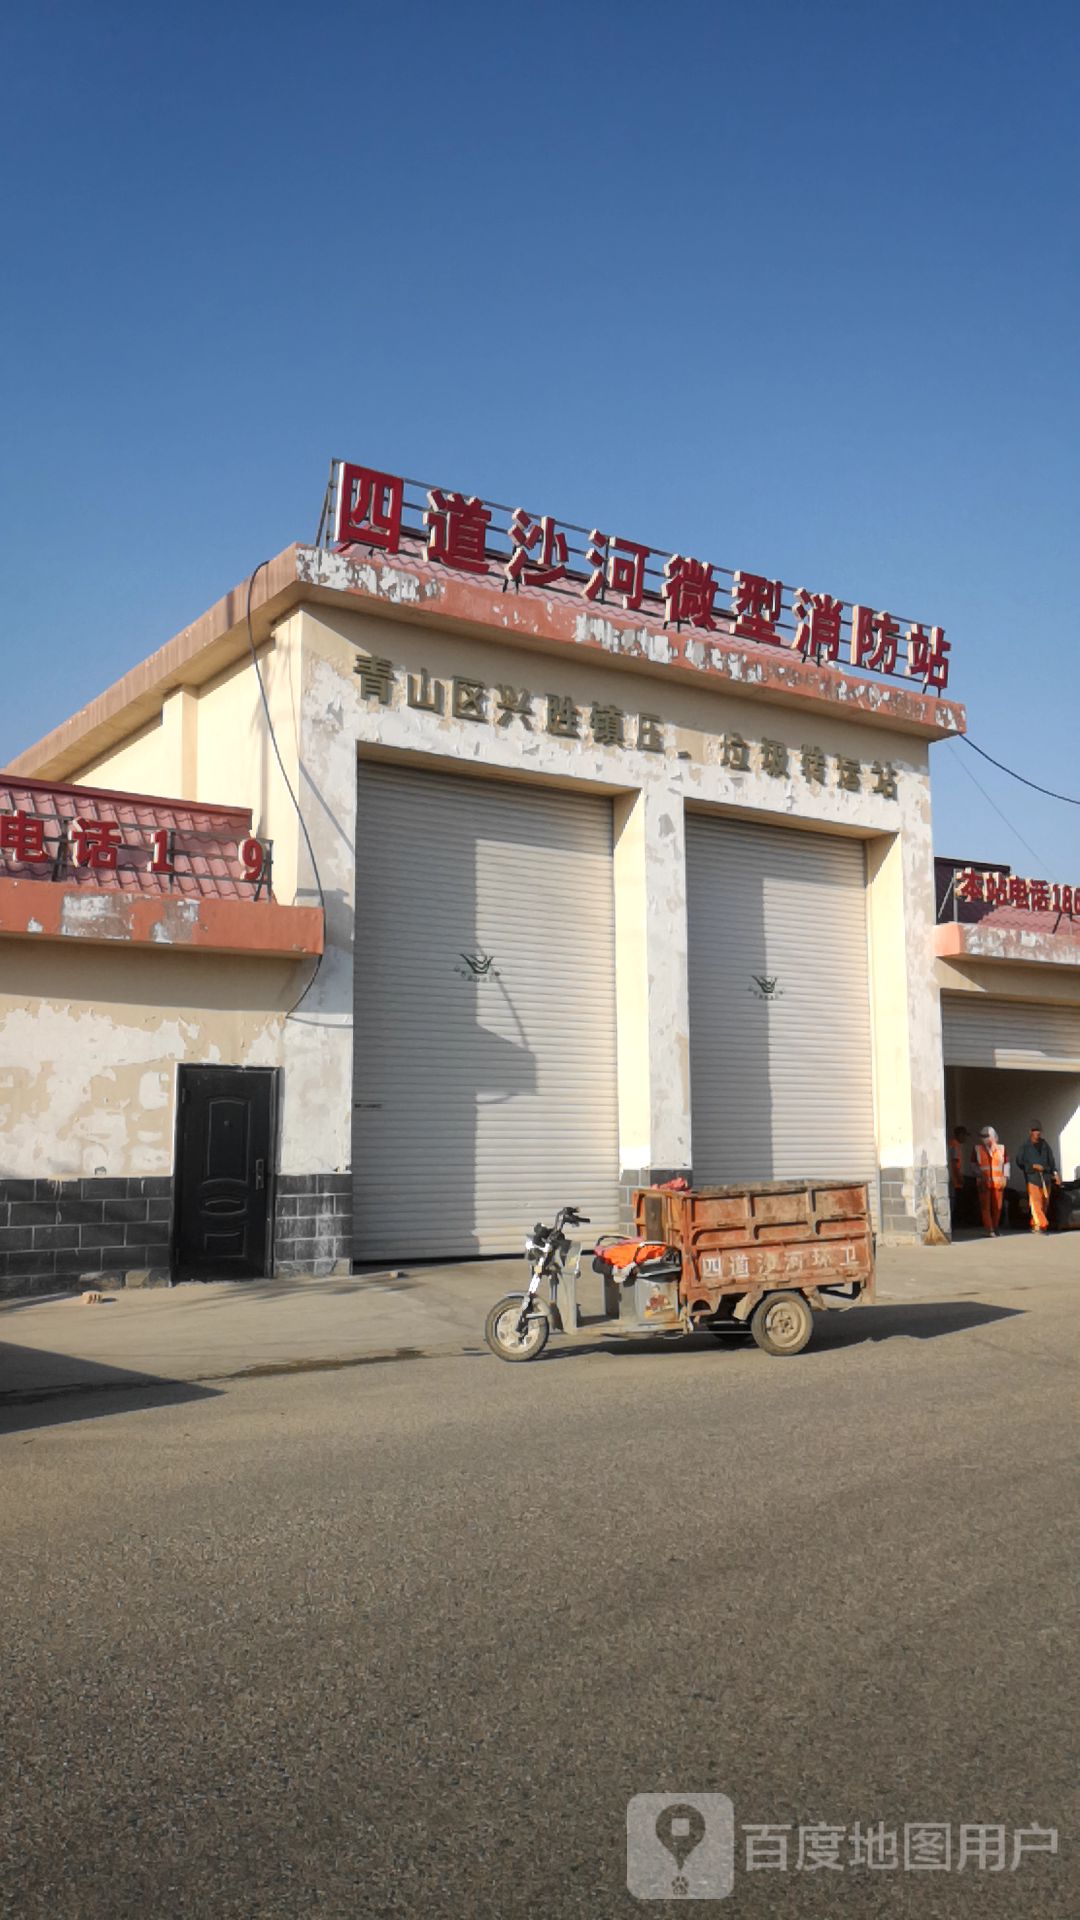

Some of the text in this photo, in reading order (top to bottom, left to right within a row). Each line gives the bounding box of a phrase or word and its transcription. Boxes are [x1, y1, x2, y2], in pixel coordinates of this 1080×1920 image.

[334, 461, 951, 689] 四道沙河微型消防站
[353, 654, 898, 800] 青山区兴胜镇压垃圾转运站
